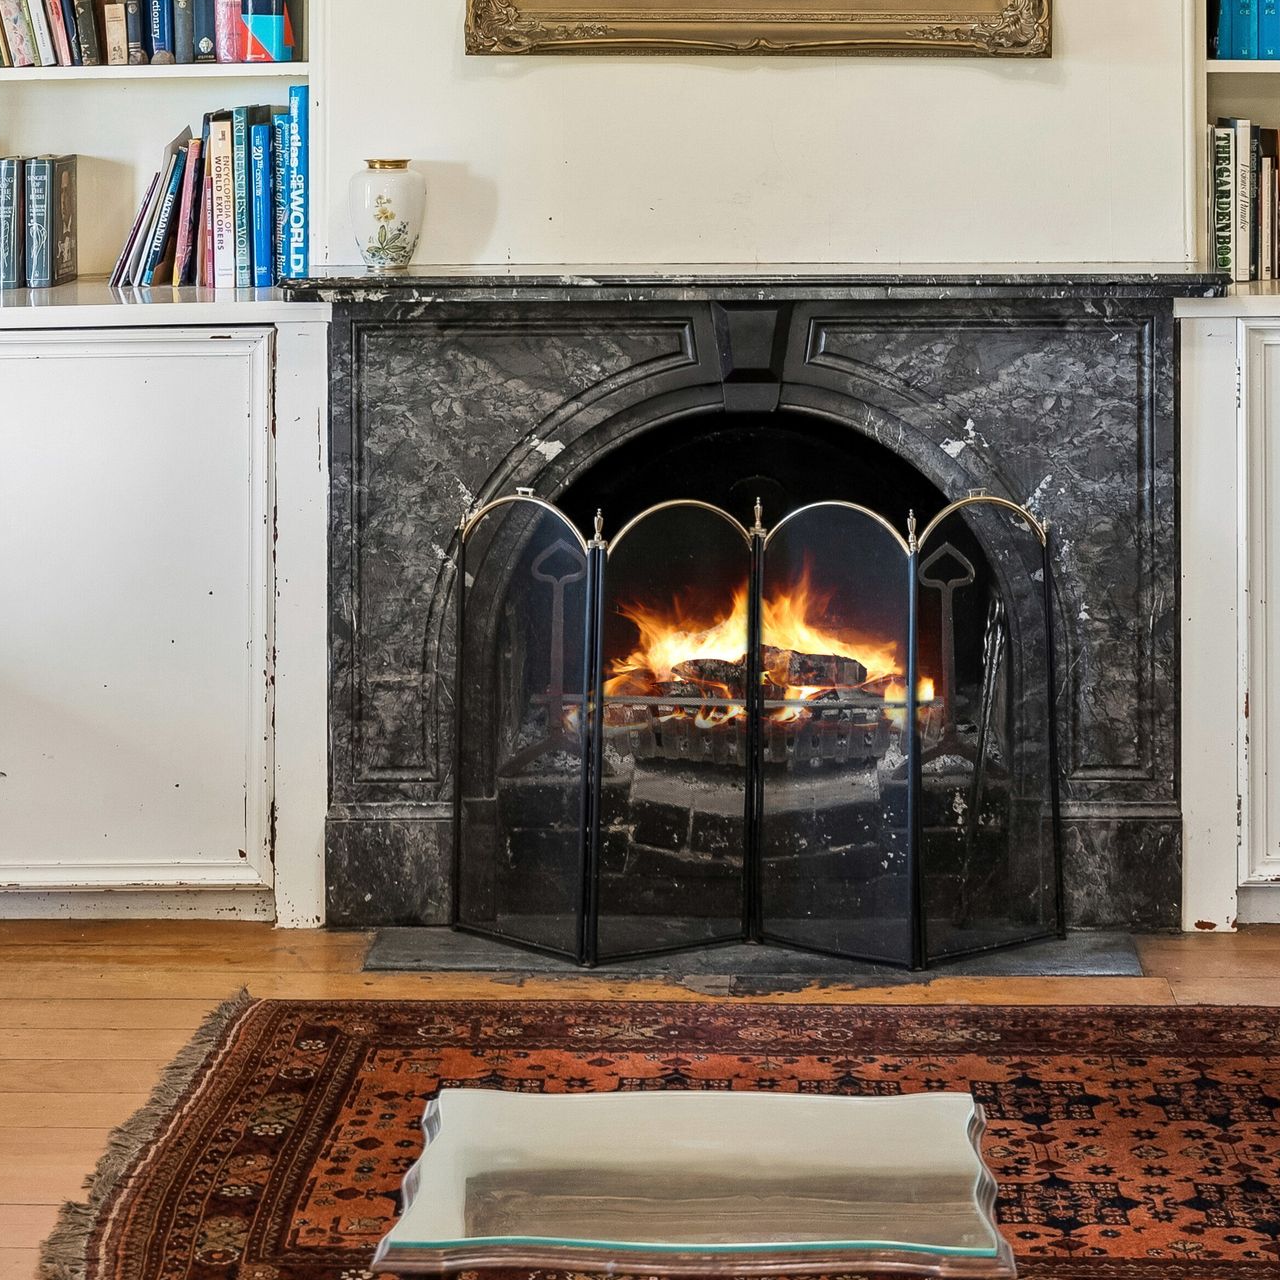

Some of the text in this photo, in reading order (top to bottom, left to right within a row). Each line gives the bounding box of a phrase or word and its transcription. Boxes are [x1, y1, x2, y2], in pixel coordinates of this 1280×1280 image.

[235, 114, 245, 213] ART TREASURES
[274, 120, 284, 166] Complete
[290, 123, 302, 167] atlas
[1216, 133, 1231, 167] THE
[222, 155, 231, 234] ENCYCLOPEDIA OF
[275, 166, 284, 191] Book
[275, 192, 285, 203] of
[297, 174, 304, 188] OF
[1216, 167, 1231, 233] GARDEN
[215, 156, 224, 250] WORLD EXPLORERS
[237, 226, 246, 273] WORLD
[276, 203, 286, 253] Australian
[290, 188, 304, 269] WORLD
